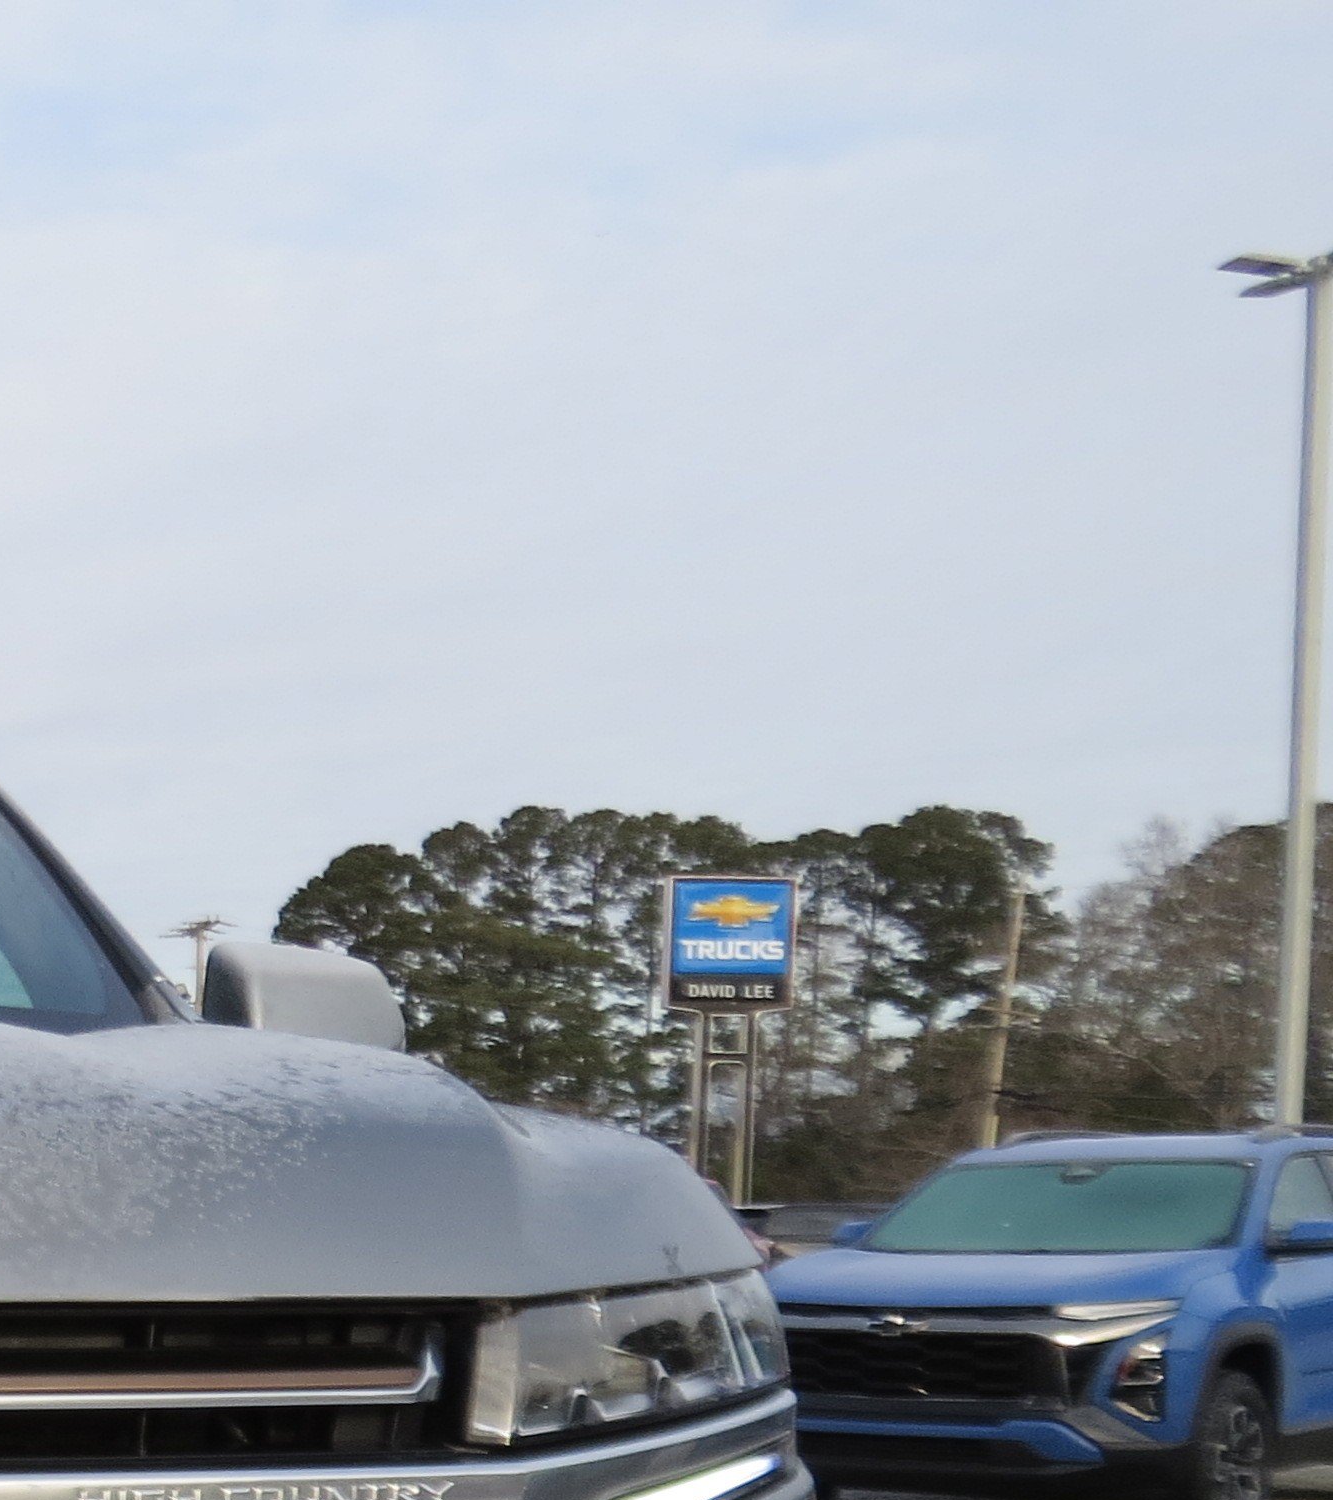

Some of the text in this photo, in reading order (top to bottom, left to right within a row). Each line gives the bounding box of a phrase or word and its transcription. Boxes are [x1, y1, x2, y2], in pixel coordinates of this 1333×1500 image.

[680, 939, 785, 960] TRUCKS
[688, 984, 775, 999] DAVID LEE
